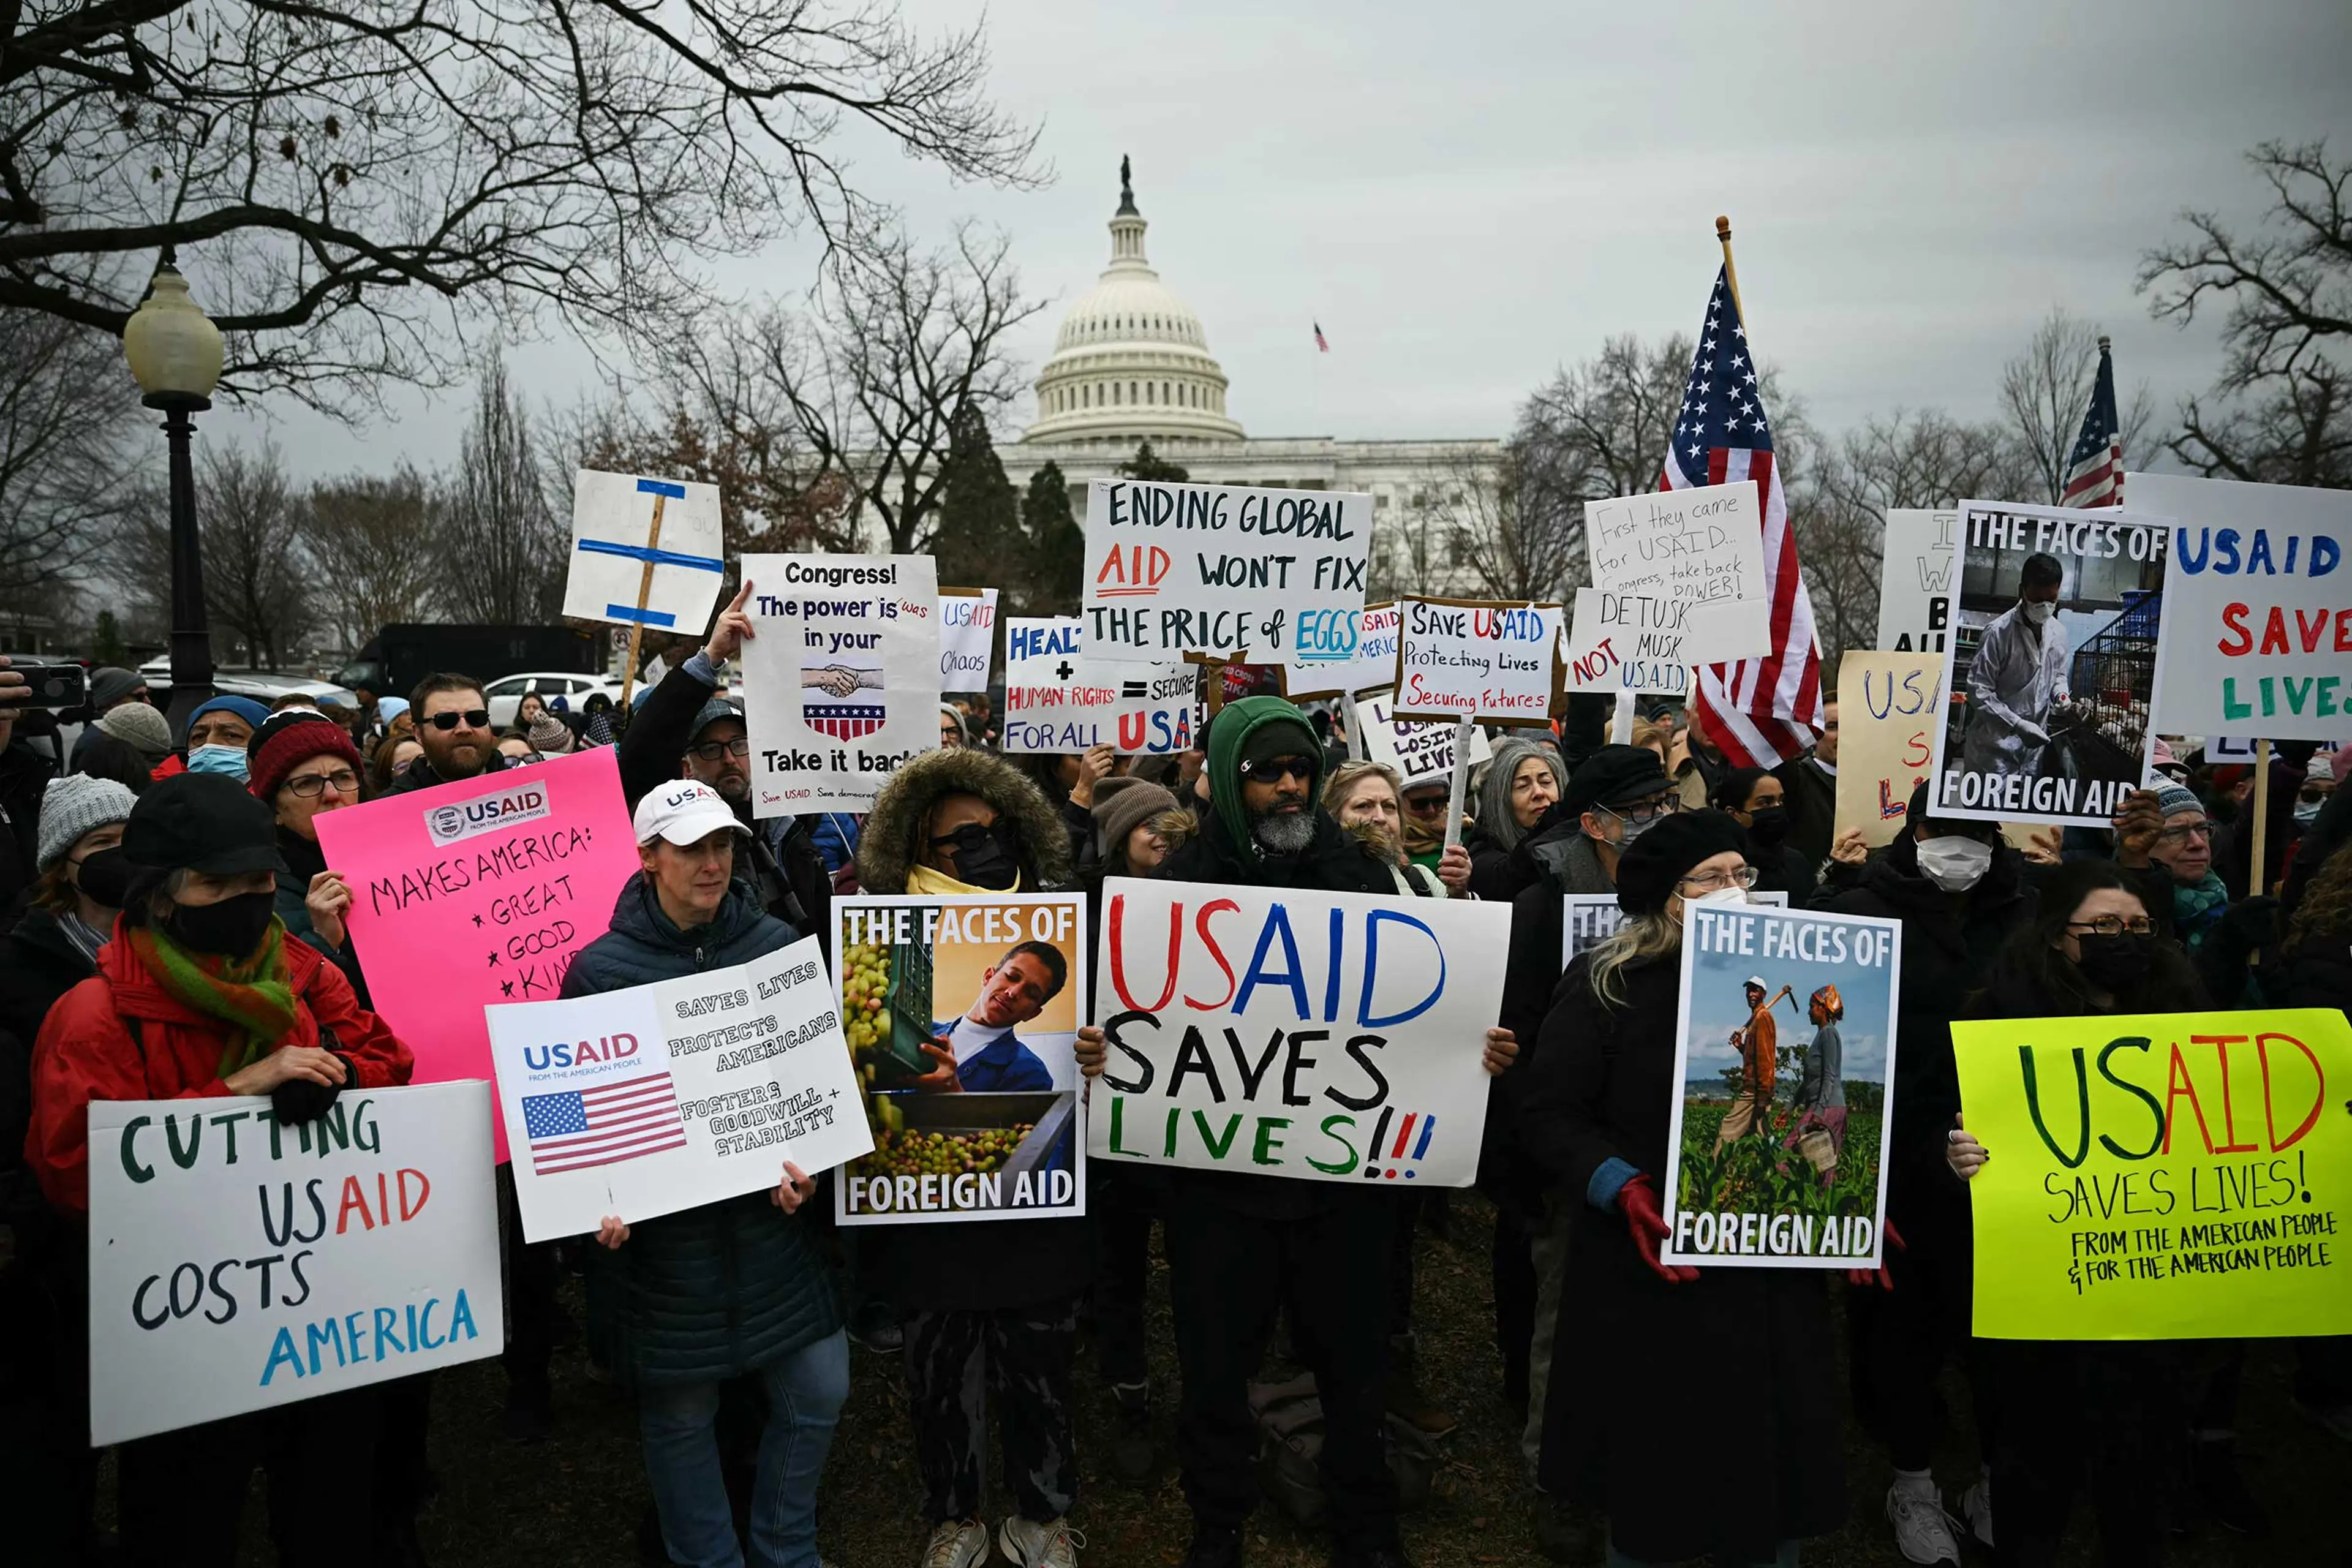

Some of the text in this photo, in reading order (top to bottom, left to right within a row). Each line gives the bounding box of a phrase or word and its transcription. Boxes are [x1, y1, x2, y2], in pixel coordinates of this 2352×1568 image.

[1110, 482, 1354, 541] ENDING GLOBAL
[1597, 497, 1738, 545] First they came
[1969, 512, 2167, 562] THE FACES OF
[2177, 526, 2341, 578] USAID
[785, 562, 897, 587] Congress!
[1096, 543, 1367, 592] AID WON'T FIX
[1596, 549, 1627, 573] for
[1670, 561, 1700, 579] take
[1705, 554, 1743, 576] back
[756, 596, 798, 616] The
[804, 598, 872, 620] power
[901, 601, 927, 619] was
[945, 603, 994, 628] USAID
[1087, 606, 1362, 652] THE PRICE of EGGS
[1362, 611, 1400, 631] SAID
[1411, 603, 1544, 642] SAVE USAID
[1600, 593, 1692, 633] DETUSK
[805, 628, 883, 654] in your
[941, 650, 984, 674] Chaos
[1011, 627, 1081, 661] HEAL
[1360, 636, 1397, 658] MERIC
[1404, 641, 1538, 678] Protecting Lives
[1572, 637, 1621, 685] NOT
[1636, 633, 1683, 662] MUSK
[1008, 687, 1115, 711] HUMAN RIGHTS
[1151, 674, 1195, 701] SECURE
[1407, 674, 1476, 714] Securing
[1482, 688, 1545, 708] Futures
[1006, 722, 1102, 748] FOR ALL
[1118, 708, 1191, 753] USA
[762, 749, 822, 772] Take
[830, 749, 848, 772] it
[1403, 745, 1461, 777] LIVE
[466, 792, 542, 822] USAID
[762, 791, 781, 804] Save
[1940, 770, 2074, 815] FOREIGN
[2082, 779, 2138, 816] AID
[497, 813, 527, 825] AMERICAN
[526, 809, 546, 818] PEOPLE
[371, 827, 592, 916] MAKES AMERICA:
[491, 875, 573, 925] GREAT
[507, 921, 575, 960] GOOD
[844, 906, 1073, 944] THE FACES OF
[1697, 912, 1890, 968] THE FACES OF
[1109, 893, 1446, 1028] USAID
[676, 961, 818, 1019] SAVES LIVES
[524, 1033, 638, 1071] USAID
[668, 1014, 778, 1057] PROTECTS
[717, 1011, 837, 1072] AMERICANS
[570, 1065, 611, 1077] AMERICAN
[613, 1058, 642, 1069] PEOPLE
[1102, 1009, 1390, 1112] SAVES
[680, 1081, 782, 1120] FOSTERS
[710, 1087, 822, 1135] GOODWILL
[2019, 1032, 2324, 1169] USAID
[715, 1106, 834, 1157] STABILITY
[1109, 1095, 1437, 1180] LIVES!!!
[258, 1168, 431, 1247] USAID
[849, 1169, 1074, 1212] FOREIGN AID
[2044, 1150, 2312, 1224] SAVES LIVES!
[1675, 1210, 1874, 1256] FOREIGN AID
[2071, 1211, 2337, 1257] FROM THE AMERICAN PEOPLE
[2068, 1242, 2332, 1295] & FOR THE AMERICAN PEOPLE
[132, 1250, 313, 1331] COSTS
[258, 1288, 478, 1387] AMERICA
